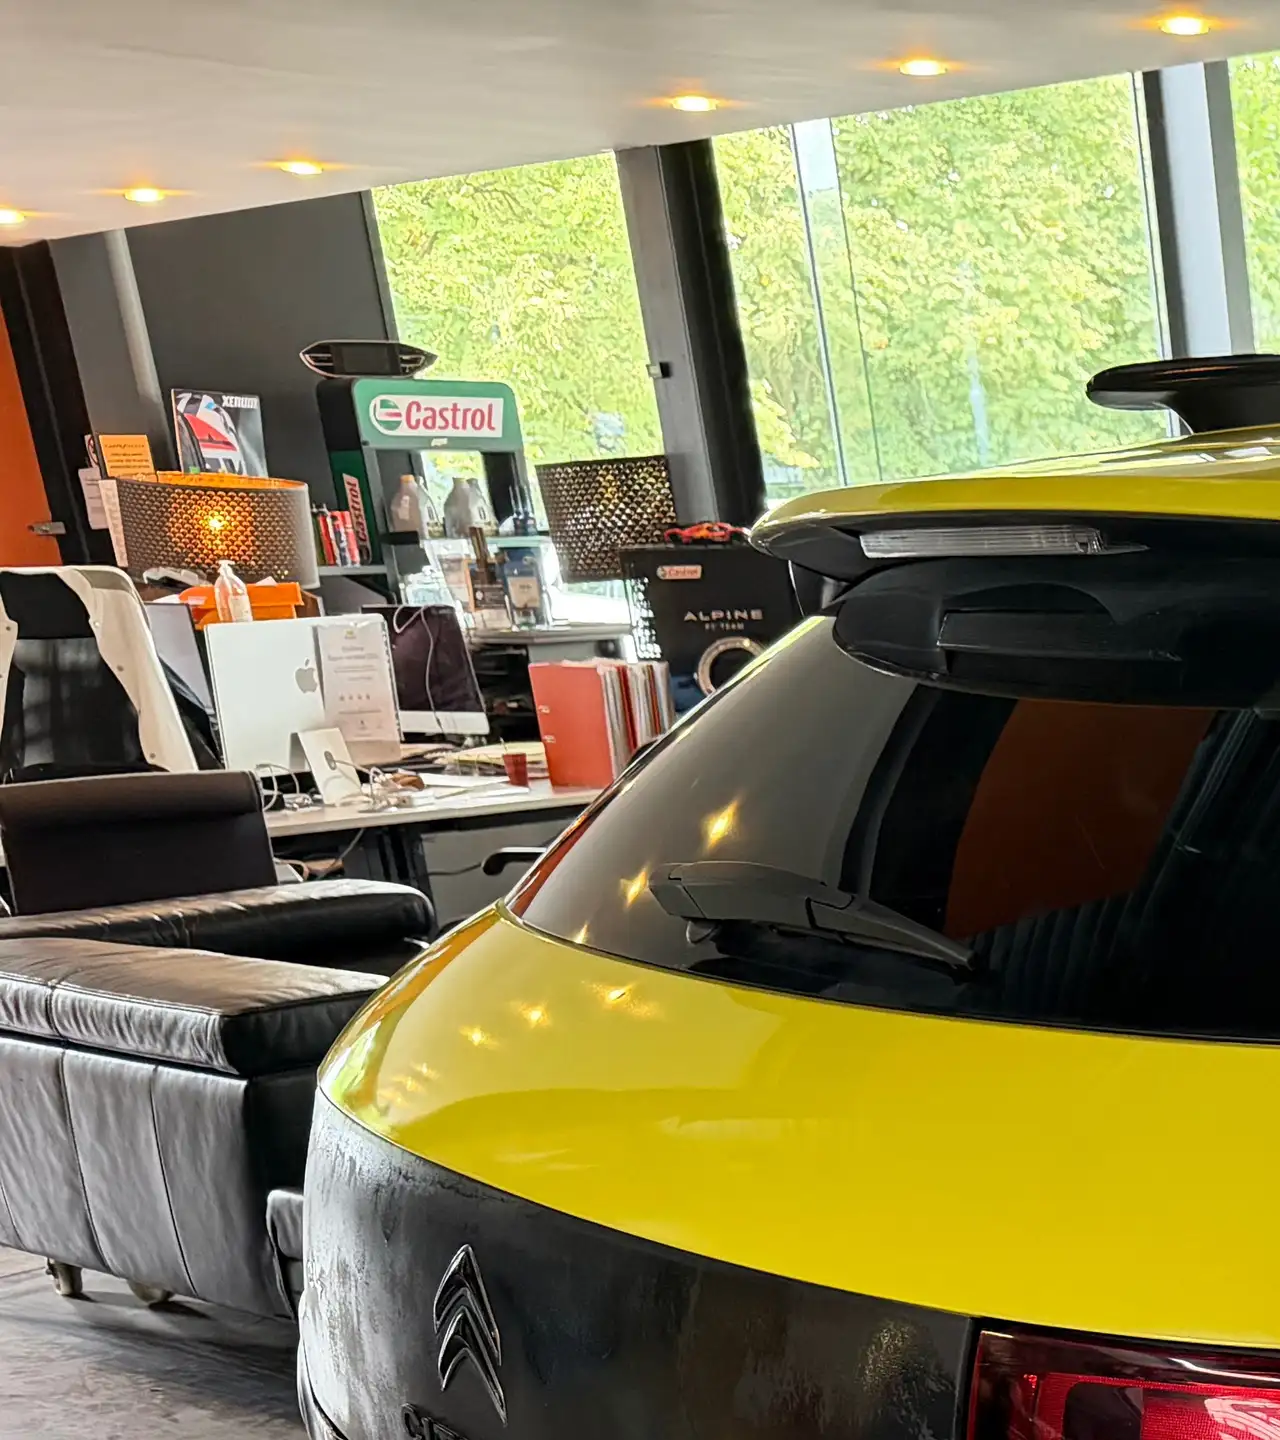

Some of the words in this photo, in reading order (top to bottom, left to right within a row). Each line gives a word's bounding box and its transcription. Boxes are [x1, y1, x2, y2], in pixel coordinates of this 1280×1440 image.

[222, 395, 259, 409] XENUM
[405, 400, 496, 431] Castrol
[346, 480, 367, 542] Castrol
[683, 609, 763, 621] ALPINE
